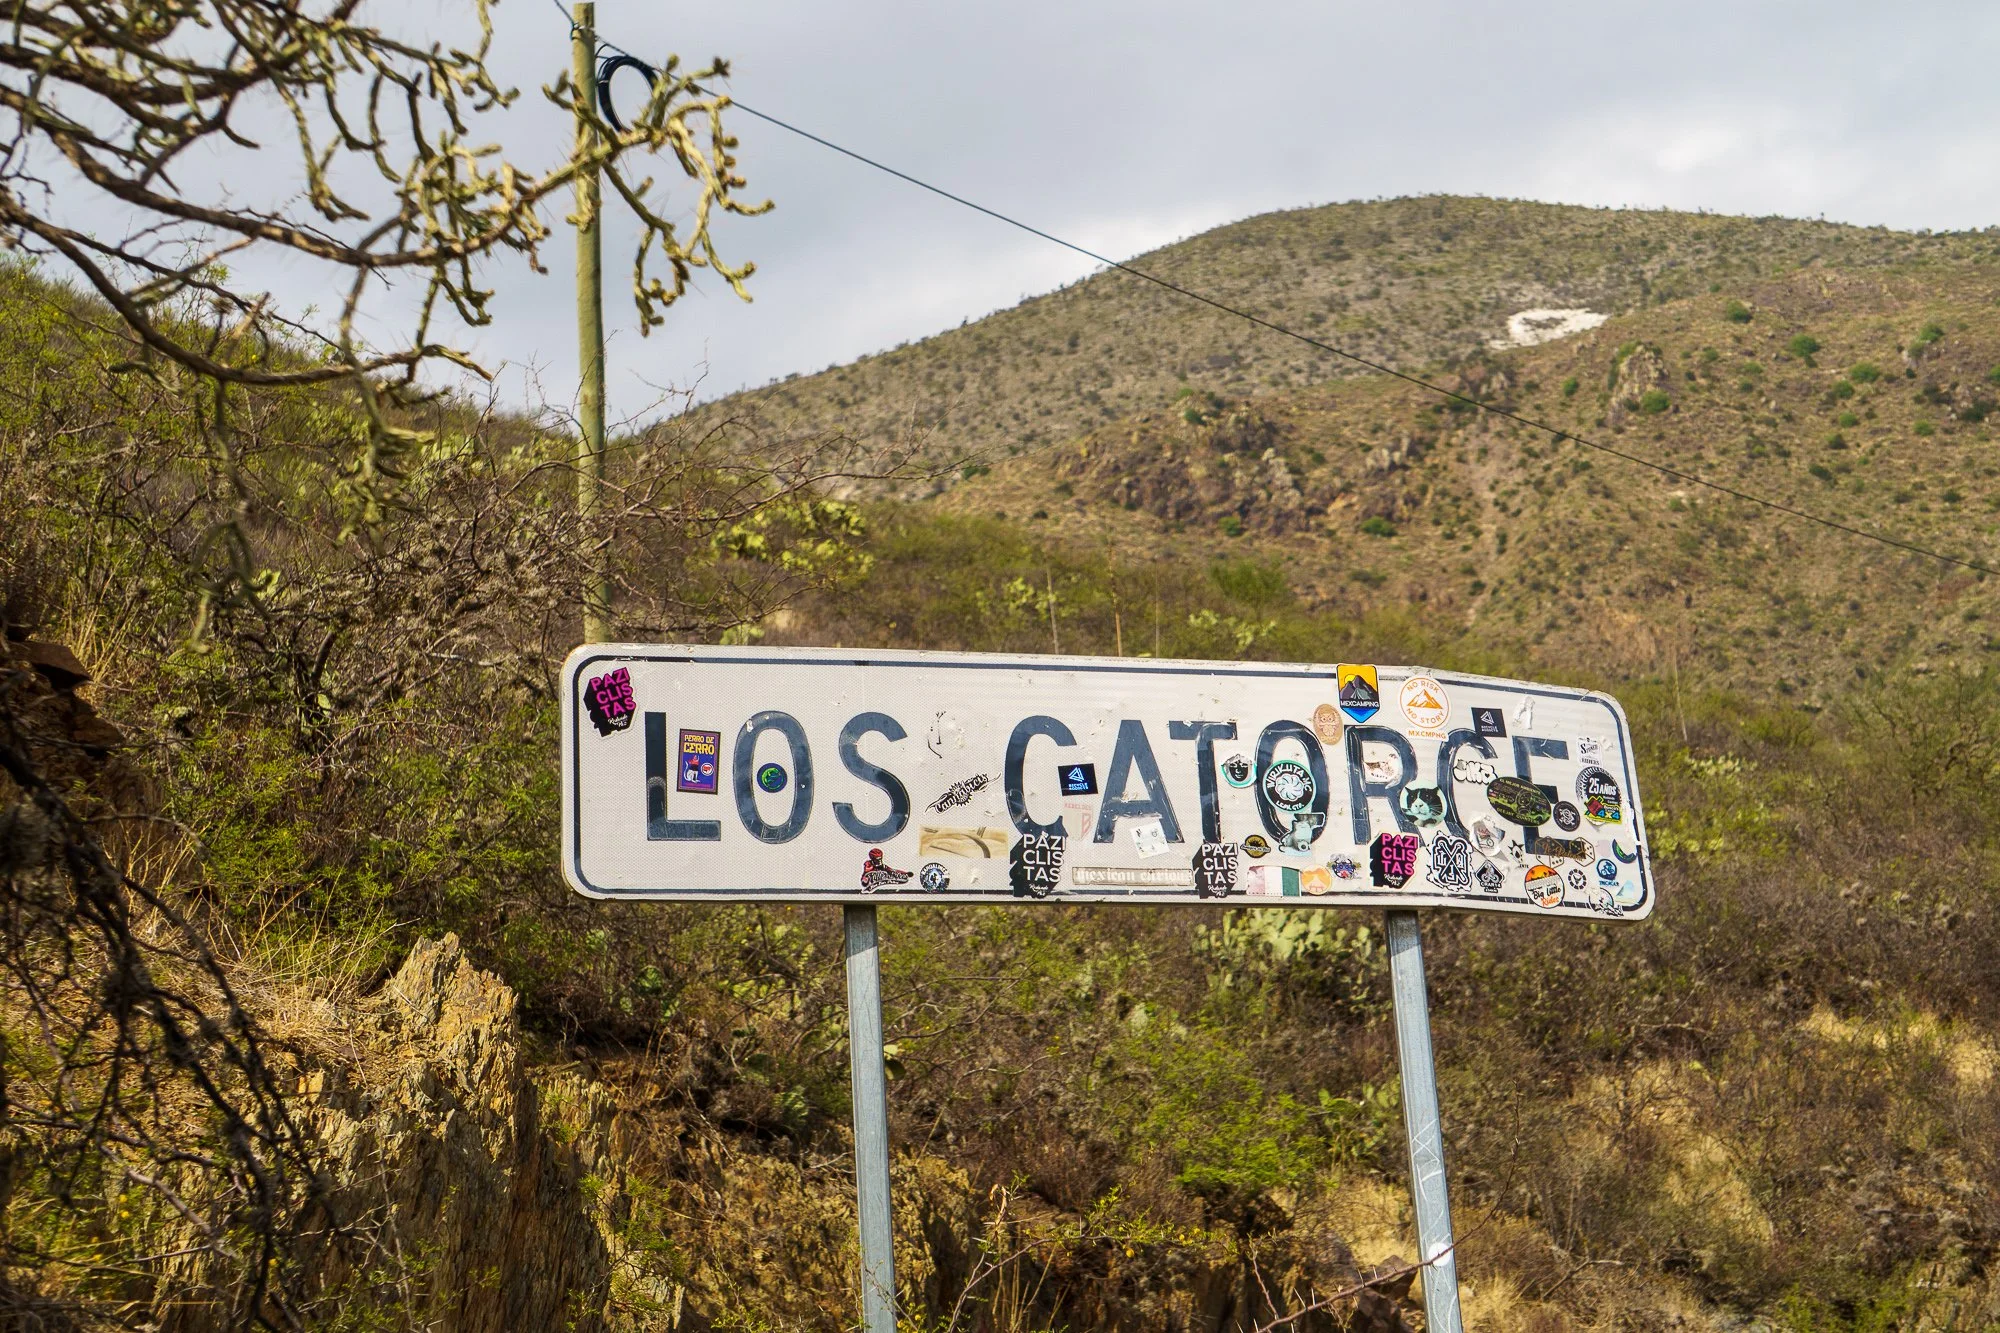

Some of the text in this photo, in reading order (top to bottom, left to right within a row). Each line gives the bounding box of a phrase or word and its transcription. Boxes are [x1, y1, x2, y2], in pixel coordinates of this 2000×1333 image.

[590, 668, 630, 691] PAZI
[1407, 681, 1440, 693] NO RISK
[596, 683, 633, 704] CLIS
[600, 697, 636, 718] TAS
[1340, 700, 1379, 708] MEXCAMPING
[1407, 708, 1445, 723] NO STORY
[684, 735, 704, 743] PERRO
[1408, 730, 1447, 739] MXCMPNG
[683, 742, 715, 755] CERRO
[645, 711, 1588, 860] LOS CATORCE
[1589, 777, 1600, 794] 25
[1599, 783, 1617, 795] AÑOS
[1023, 834, 1067, 850] PAZI
[1382, 833, 1419, 848] PAZI
[1201, 843, 1238, 856] PAZI
[1382, 847, 1416, 861] CLIS
[1023, 850, 1063, 866] CLIS
[1203, 857, 1238, 870] CLIS
[1023, 866, 1060, 882] TAS
[1383, 860, 1415, 875] TAS
[1203, 871, 1238, 884] TAS
[1532, 890, 1545, 900] Big
